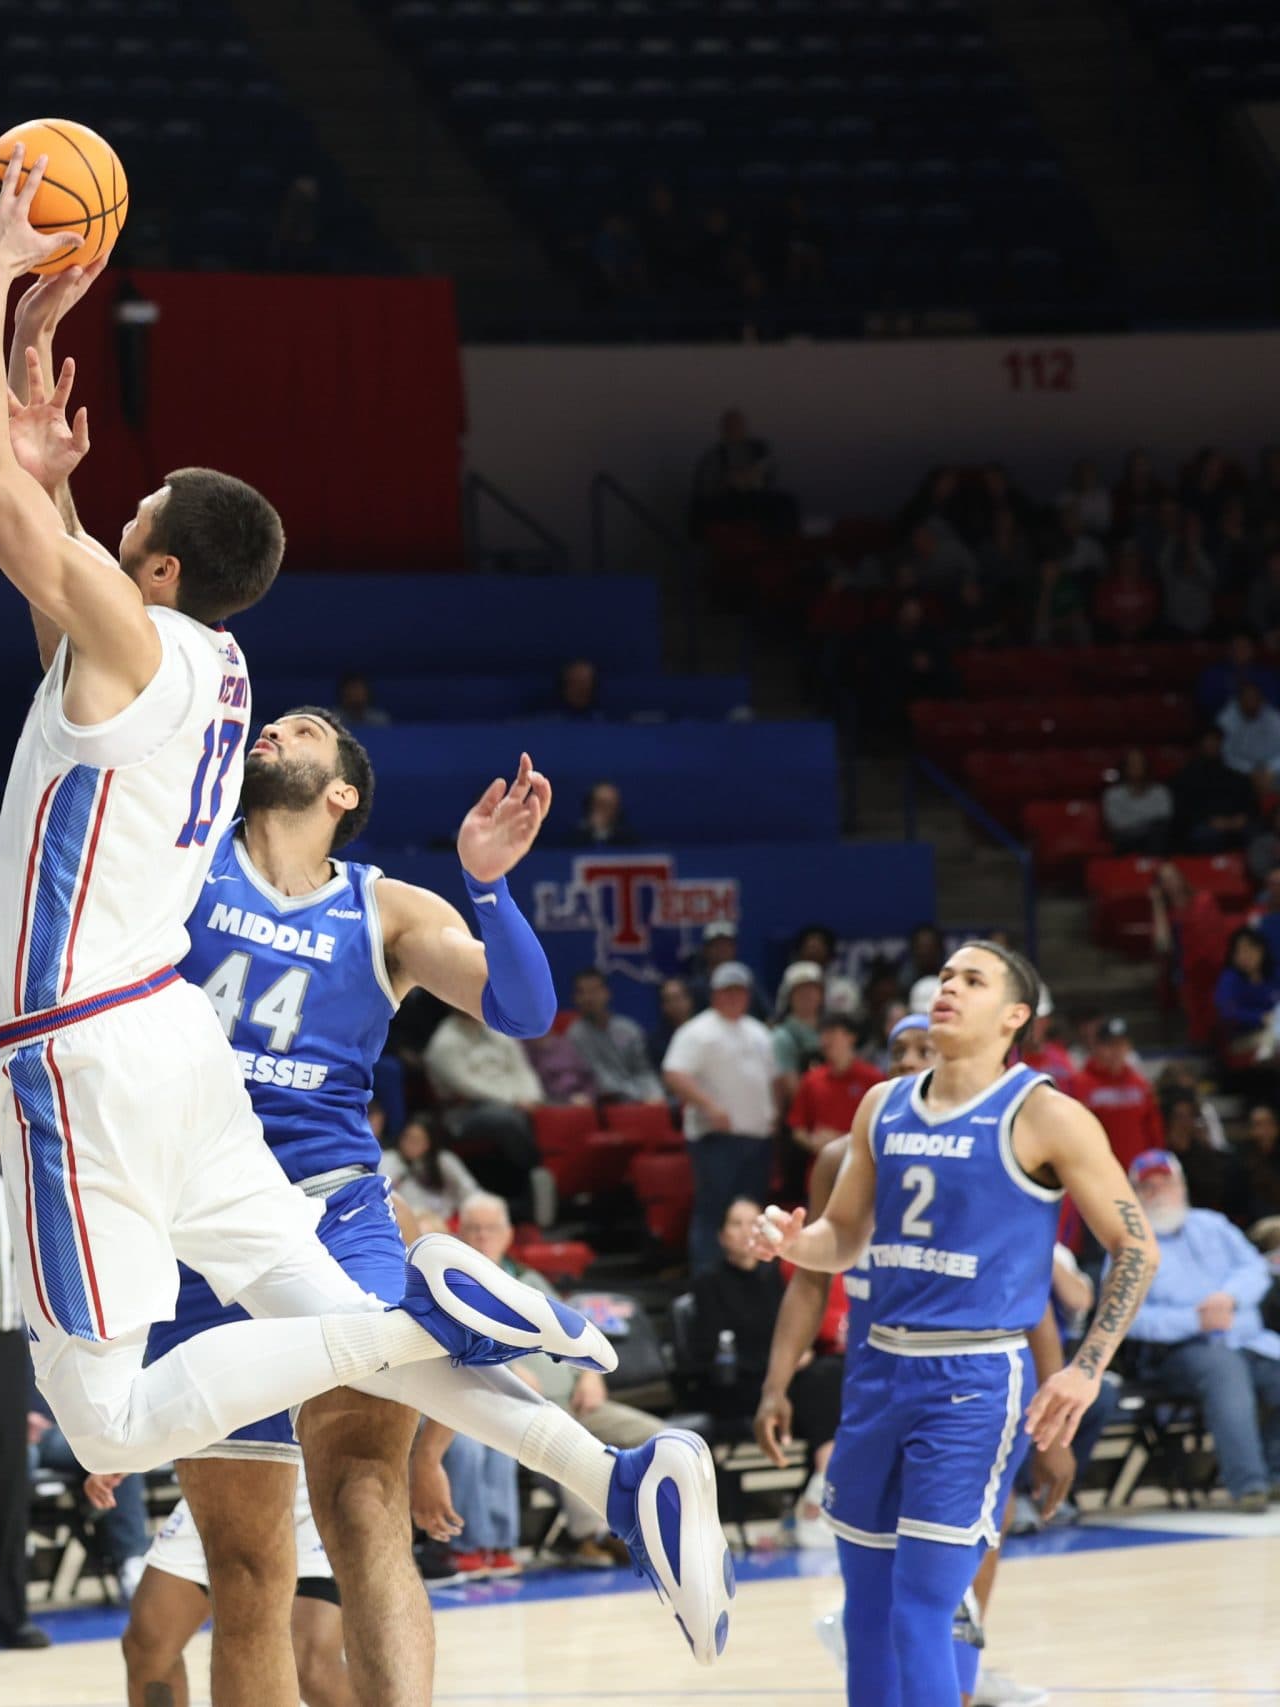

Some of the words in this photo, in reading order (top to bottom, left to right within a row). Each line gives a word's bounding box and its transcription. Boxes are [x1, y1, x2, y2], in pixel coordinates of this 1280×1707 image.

[1002, 350, 1078, 393] 112
[207, 902, 336, 964] MIDDLE
[202, 950, 312, 1054] 44
[235, 1050, 329, 1090] ESSEE
[883, 1132, 976, 1159] MIDDLE
[901, 1164, 936, 1238] 2
